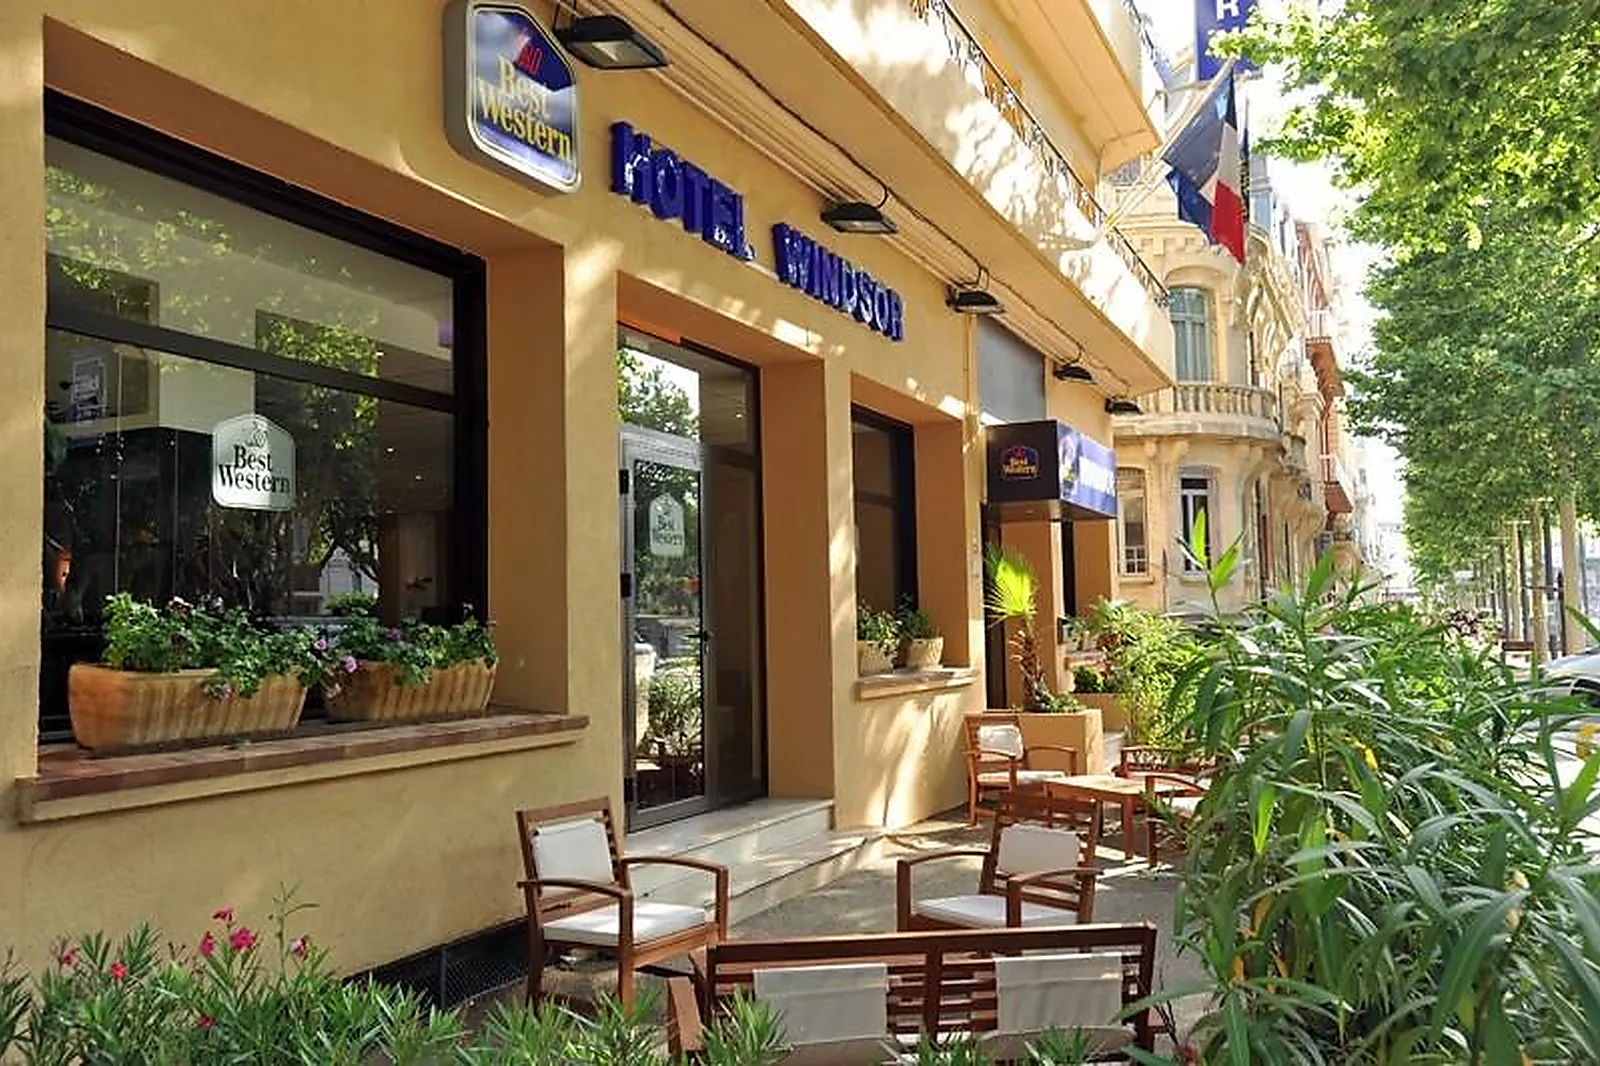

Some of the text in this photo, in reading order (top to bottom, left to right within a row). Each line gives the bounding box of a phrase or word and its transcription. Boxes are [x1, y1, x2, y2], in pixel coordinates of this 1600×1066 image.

[498, 55, 551, 118] Best
[478, 77, 572, 161] Western
[609, 121, 905, 342] HOTEL WINDSOR
[219, 464, 290, 493] Western
[234, 445, 272, 472] Best
